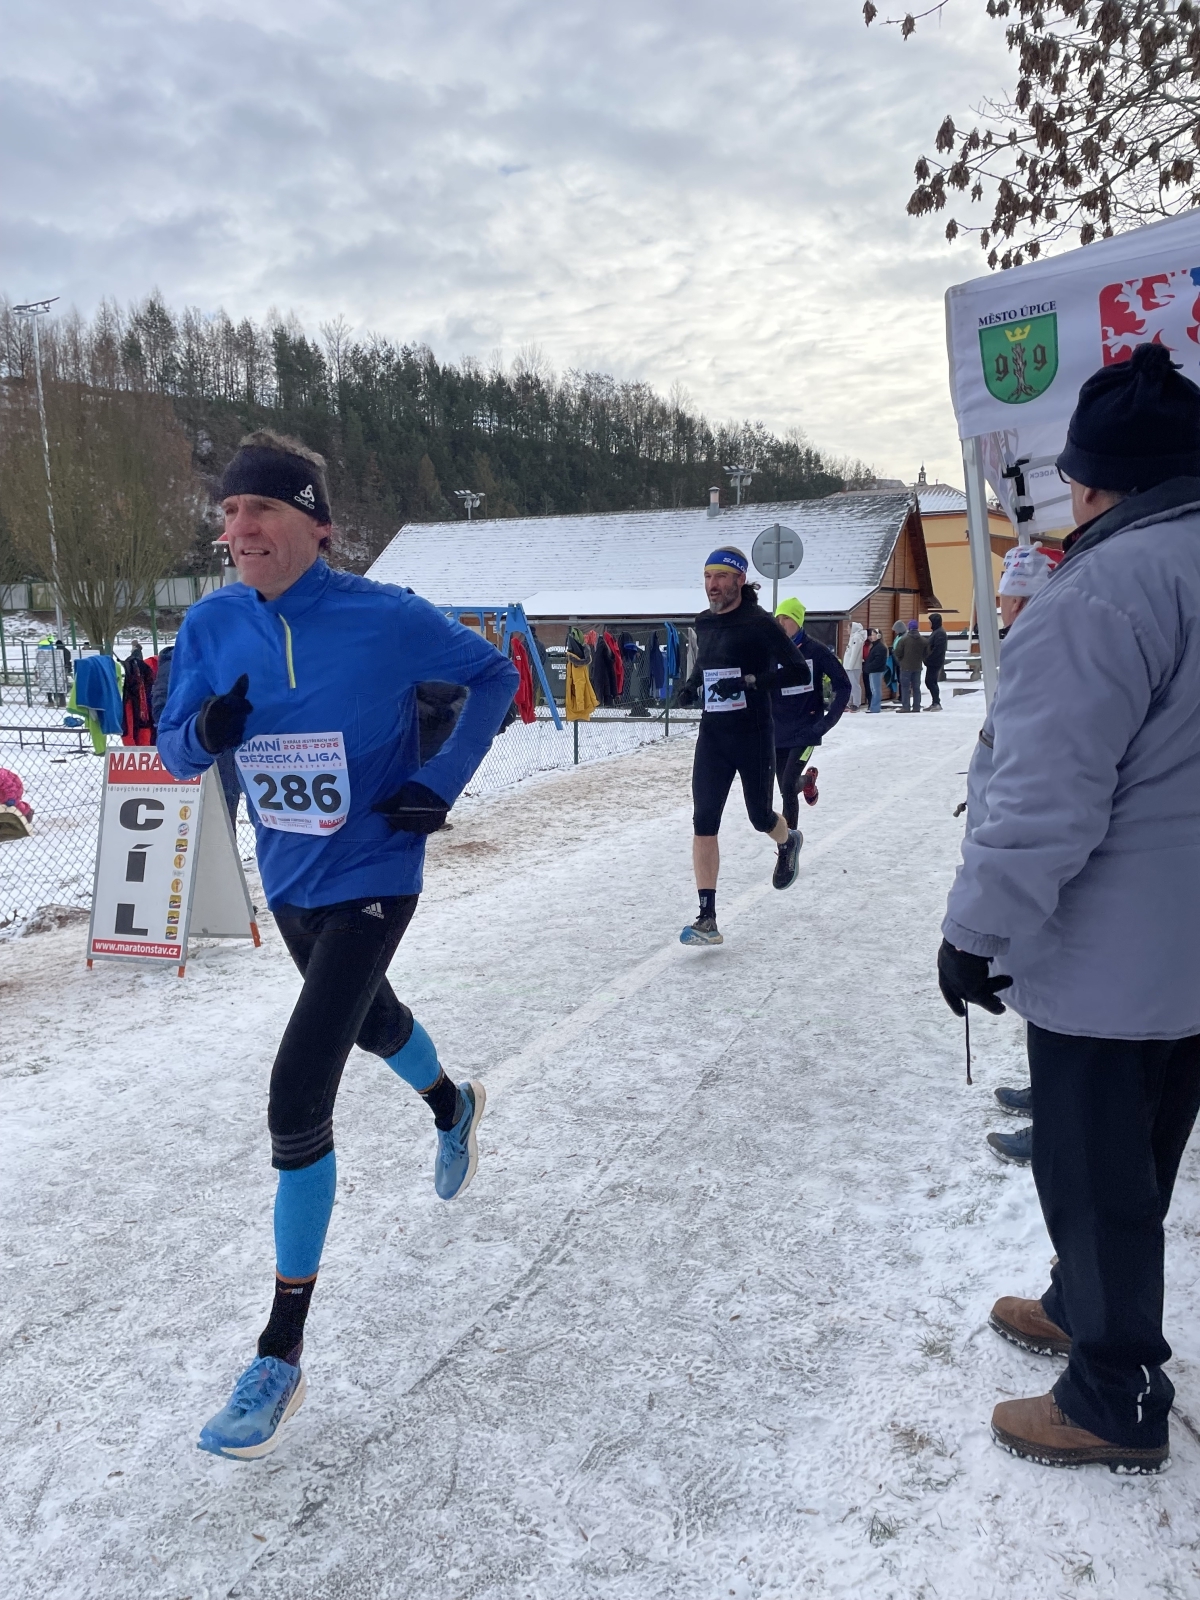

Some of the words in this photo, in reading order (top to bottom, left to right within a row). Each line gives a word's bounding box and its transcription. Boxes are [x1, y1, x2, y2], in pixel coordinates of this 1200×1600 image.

[978, 309, 1017, 327] MĚSTO
[1020, 300, 1057, 317] ÚPICE
[239, 738, 281, 753] ZIMNÍ
[283, 742, 339, 750] 2025-2026
[239, 752, 305, 764] BĚŽECKÁ
[308, 752, 341, 763] LIGA
[253, 773, 342, 813] 286
[361, 908, 385, 920] adidas
[95, 941, 178, 956] www.maratonstav.cz
